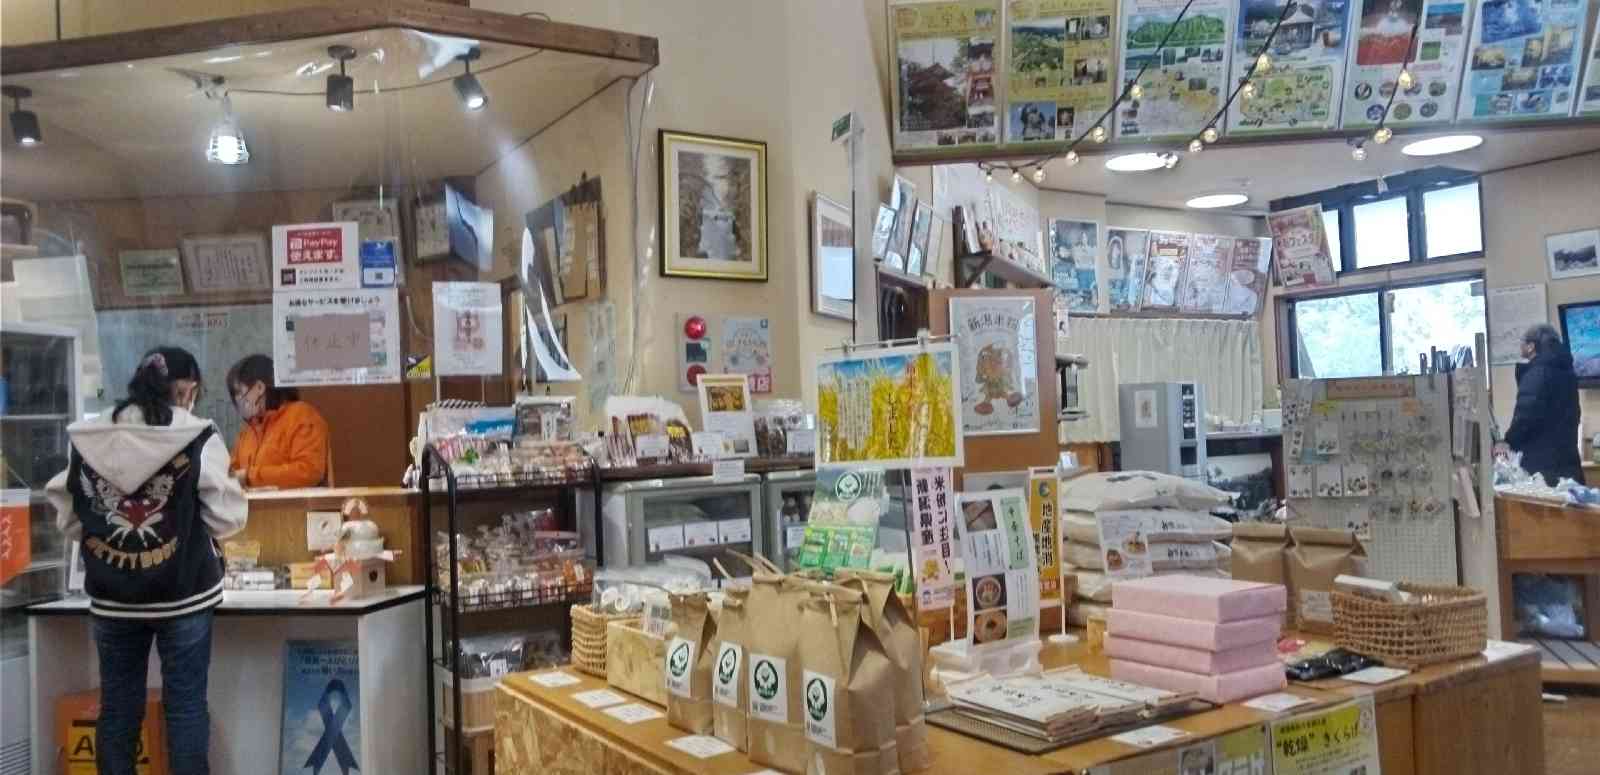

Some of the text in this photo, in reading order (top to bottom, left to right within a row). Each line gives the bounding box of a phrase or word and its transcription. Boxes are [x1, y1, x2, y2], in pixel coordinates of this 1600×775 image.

[303, 237, 338, 249] PayPay
[290, 249, 340, 262] 使えます。
